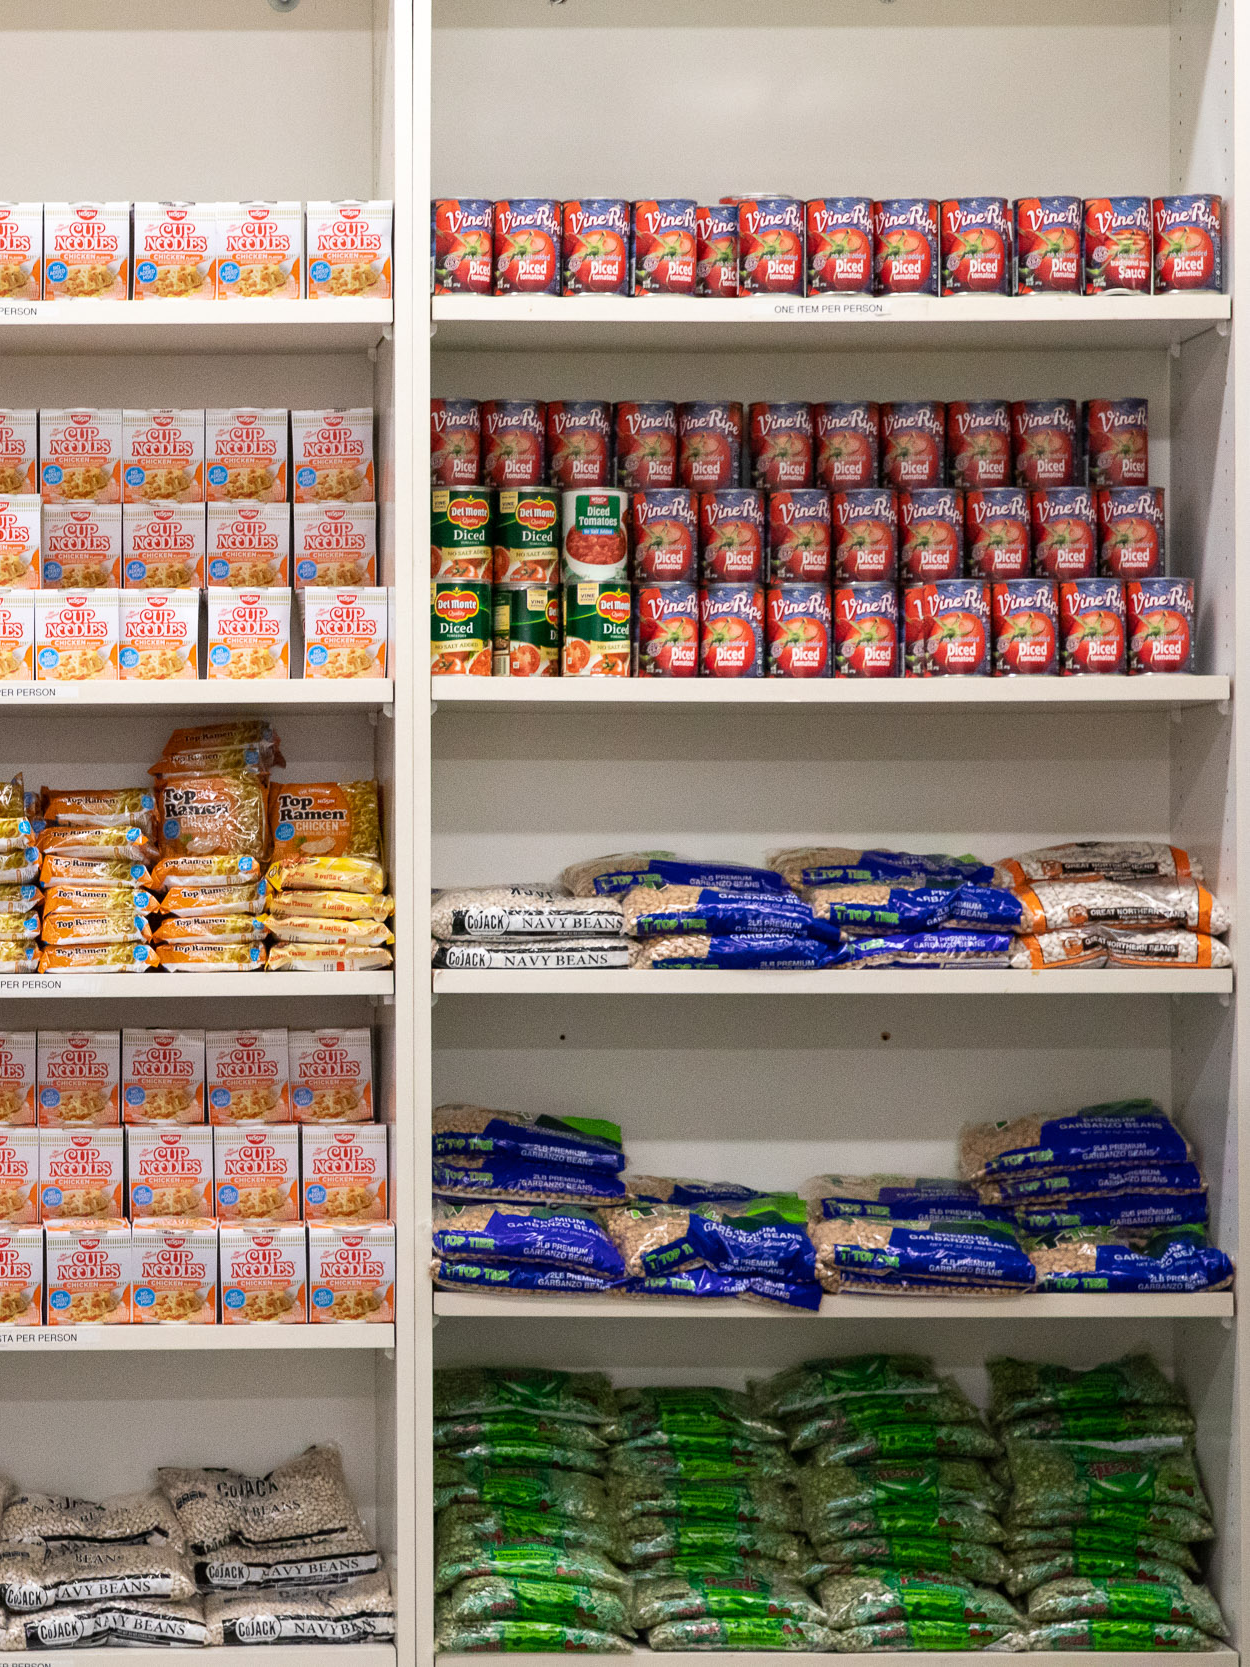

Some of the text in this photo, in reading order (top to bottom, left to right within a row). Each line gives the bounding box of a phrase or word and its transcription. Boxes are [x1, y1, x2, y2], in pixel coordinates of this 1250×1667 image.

[159, 222, 195, 237] CUP
[332, 221, 369, 237] CUP
[144, 235, 207, 253] NOODLES
[318, 234, 382, 251] NOODLES
[1173, 256, 1204, 271] Diced
[1118, 267, 1146, 279] Sauce
[774, 304, 883, 314] ONE ITEM PER PERSON
[451, 507, 489, 517] Del Monte
[579, 515, 618, 526] Tomatoes
[440, 623, 473, 634] Diced
[17, 688, 56, 697] PERSON
[278, 793, 315, 812] Top
[279, 808, 347, 823] Ramen
[295, 821, 339, 831] CHICKEN
[848, 909, 871, 922] TOP
[1090, 909, 1114, 917] GREAT
[521, 917, 623, 929] NAVY BEANS
[504, 954, 608, 966] NAVY BEANS
[0, 980, 20, 989] PER
[22, 980, 62, 989] PERSON
[16, 1334, 36, 1343] PER
[38, 1333, 78, 1342] PERSON
[295, 1623, 338, 1635] NAVY
